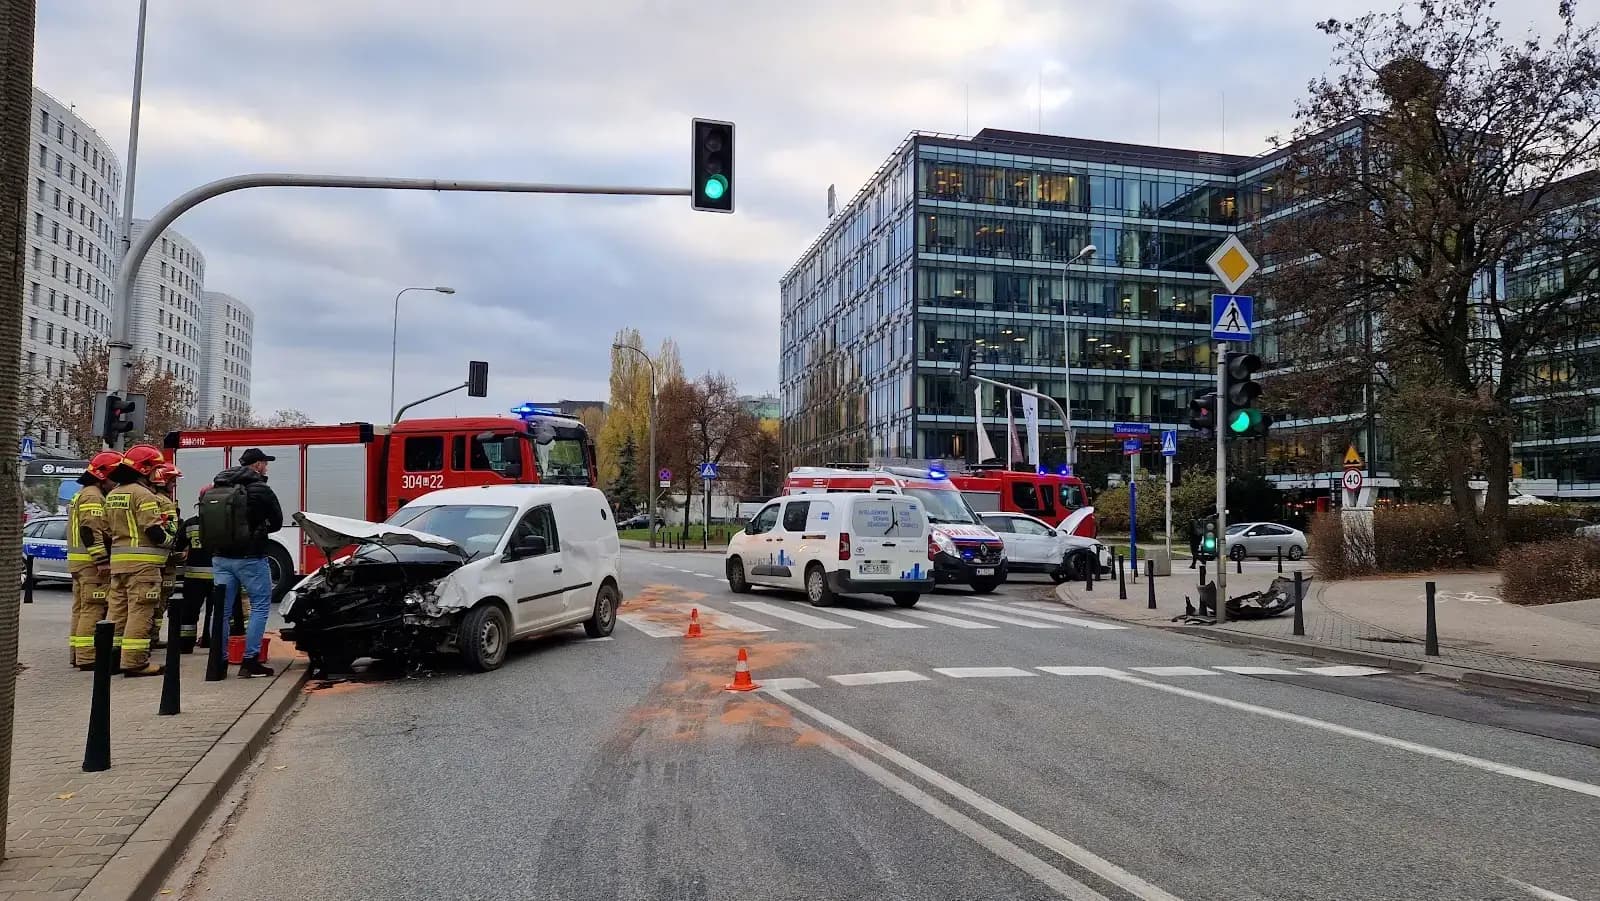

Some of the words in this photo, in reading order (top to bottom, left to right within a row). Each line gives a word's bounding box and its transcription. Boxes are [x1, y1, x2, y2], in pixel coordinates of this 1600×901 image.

[402, 475, 422, 488] 304
[430, 475, 444, 488] 22
[1346, 474, 1360, 485] 40
